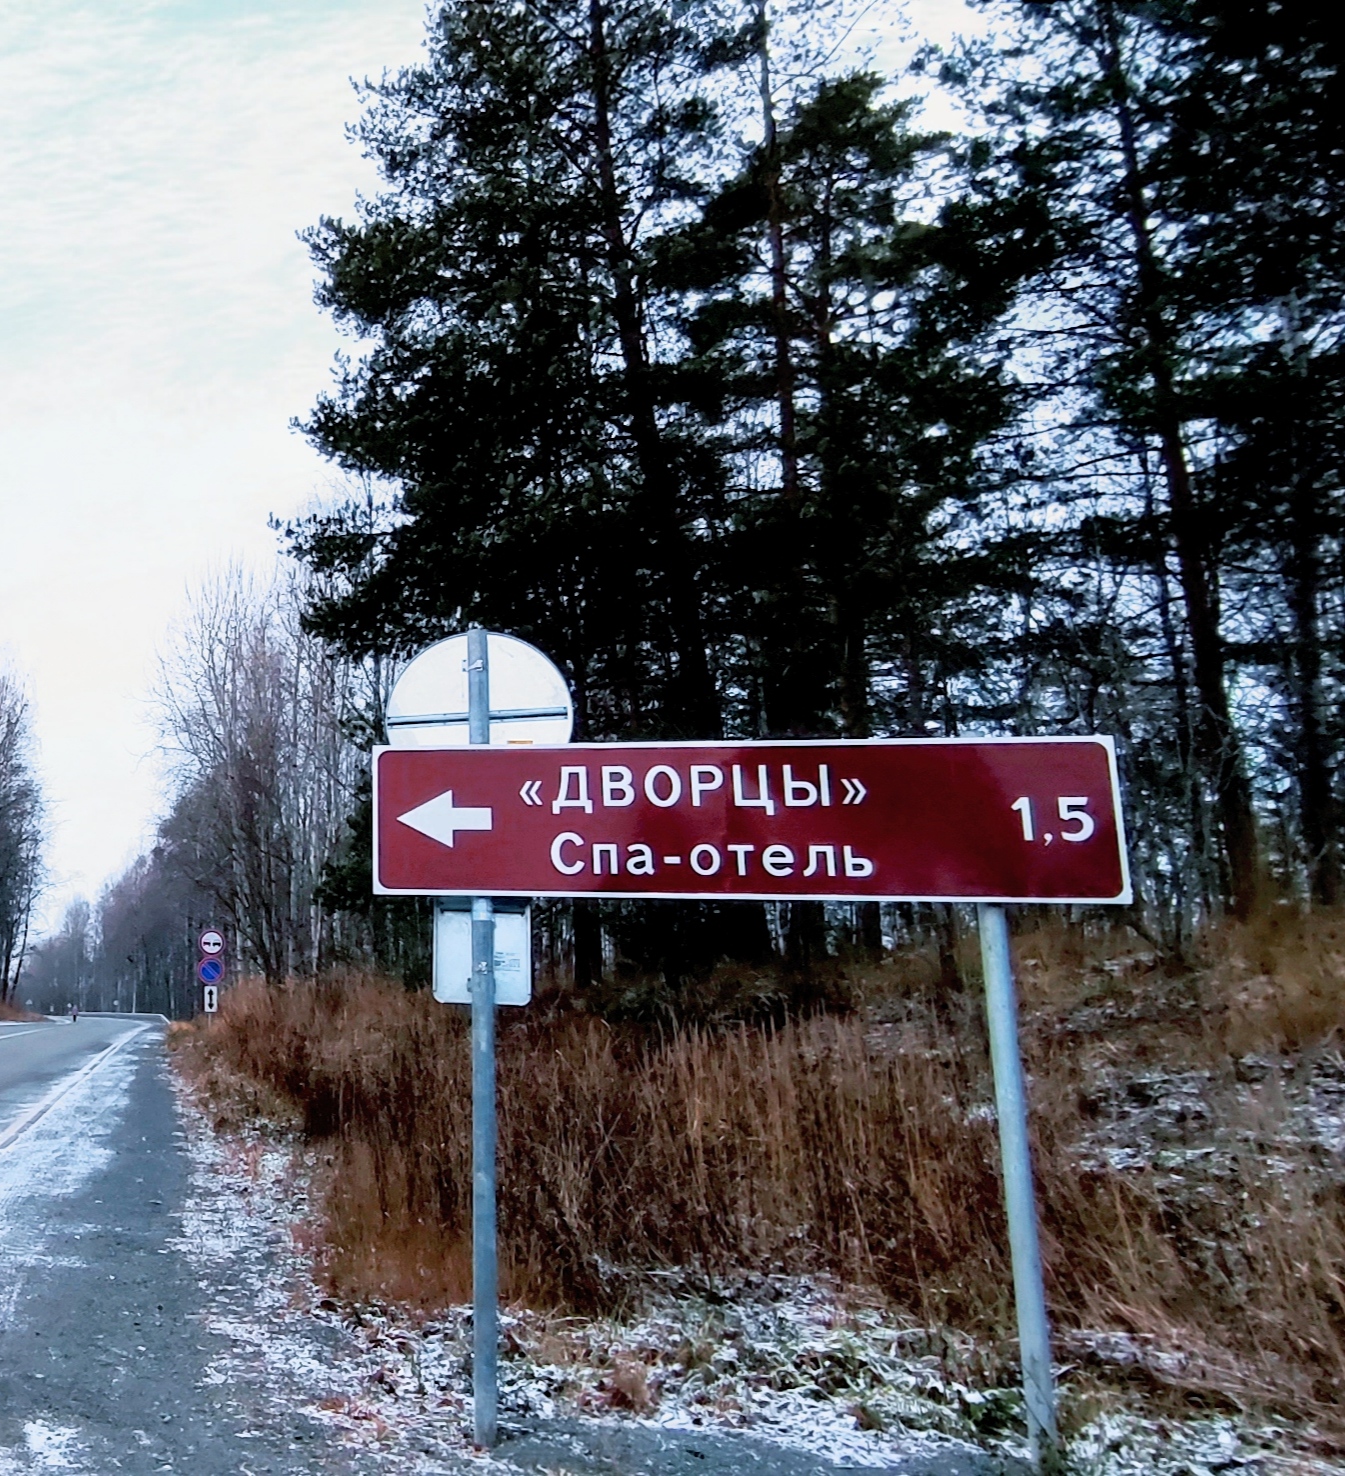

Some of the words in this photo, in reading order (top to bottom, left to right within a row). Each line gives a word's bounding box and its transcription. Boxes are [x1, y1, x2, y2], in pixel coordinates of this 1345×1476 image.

[519, 764, 867, 815] «ДВОРЦЫ»
[1010, 796, 1095, 845] 1,5
[550, 832, 874, 877] Спа-отель
